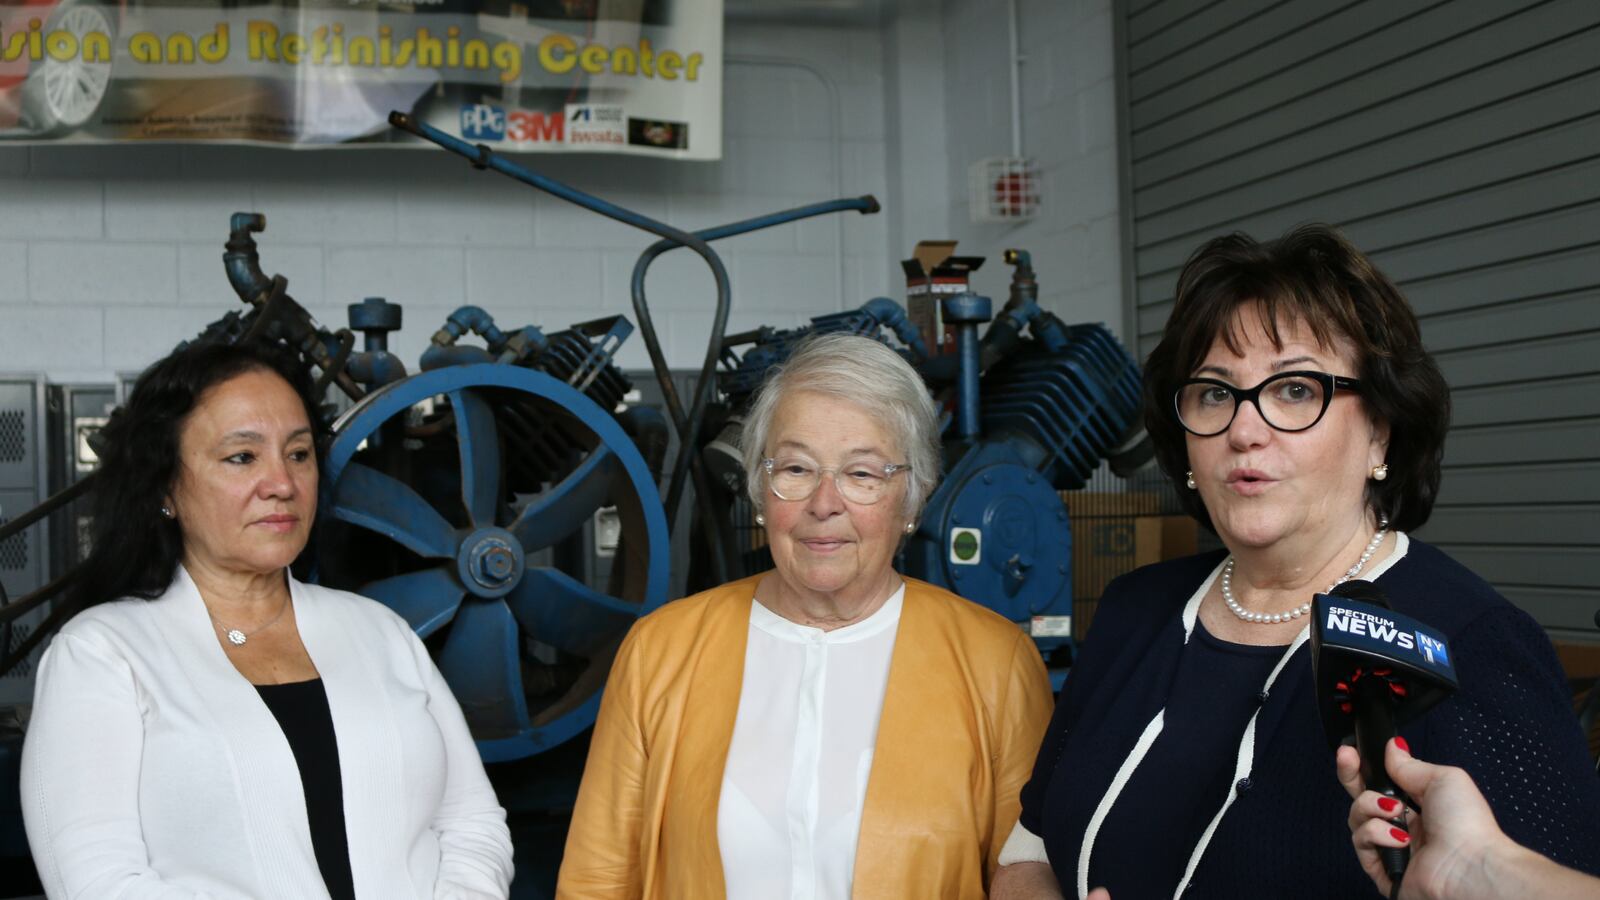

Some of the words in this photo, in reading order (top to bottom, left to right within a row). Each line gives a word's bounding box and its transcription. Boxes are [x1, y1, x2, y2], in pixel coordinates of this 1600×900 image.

[0, 17, 112, 64] sion
[129, 22, 230, 64] and
[247, 20, 523, 82] Refinishing
[538, 33, 704, 81] Center
[463, 104, 505, 135] PPG
[507, 111, 565, 144] 3M
[1326, 613, 1415, 650] NEWS
[1329, 606, 1395, 629] SPECTRUM
[1420, 635, 1444, 652] NY
